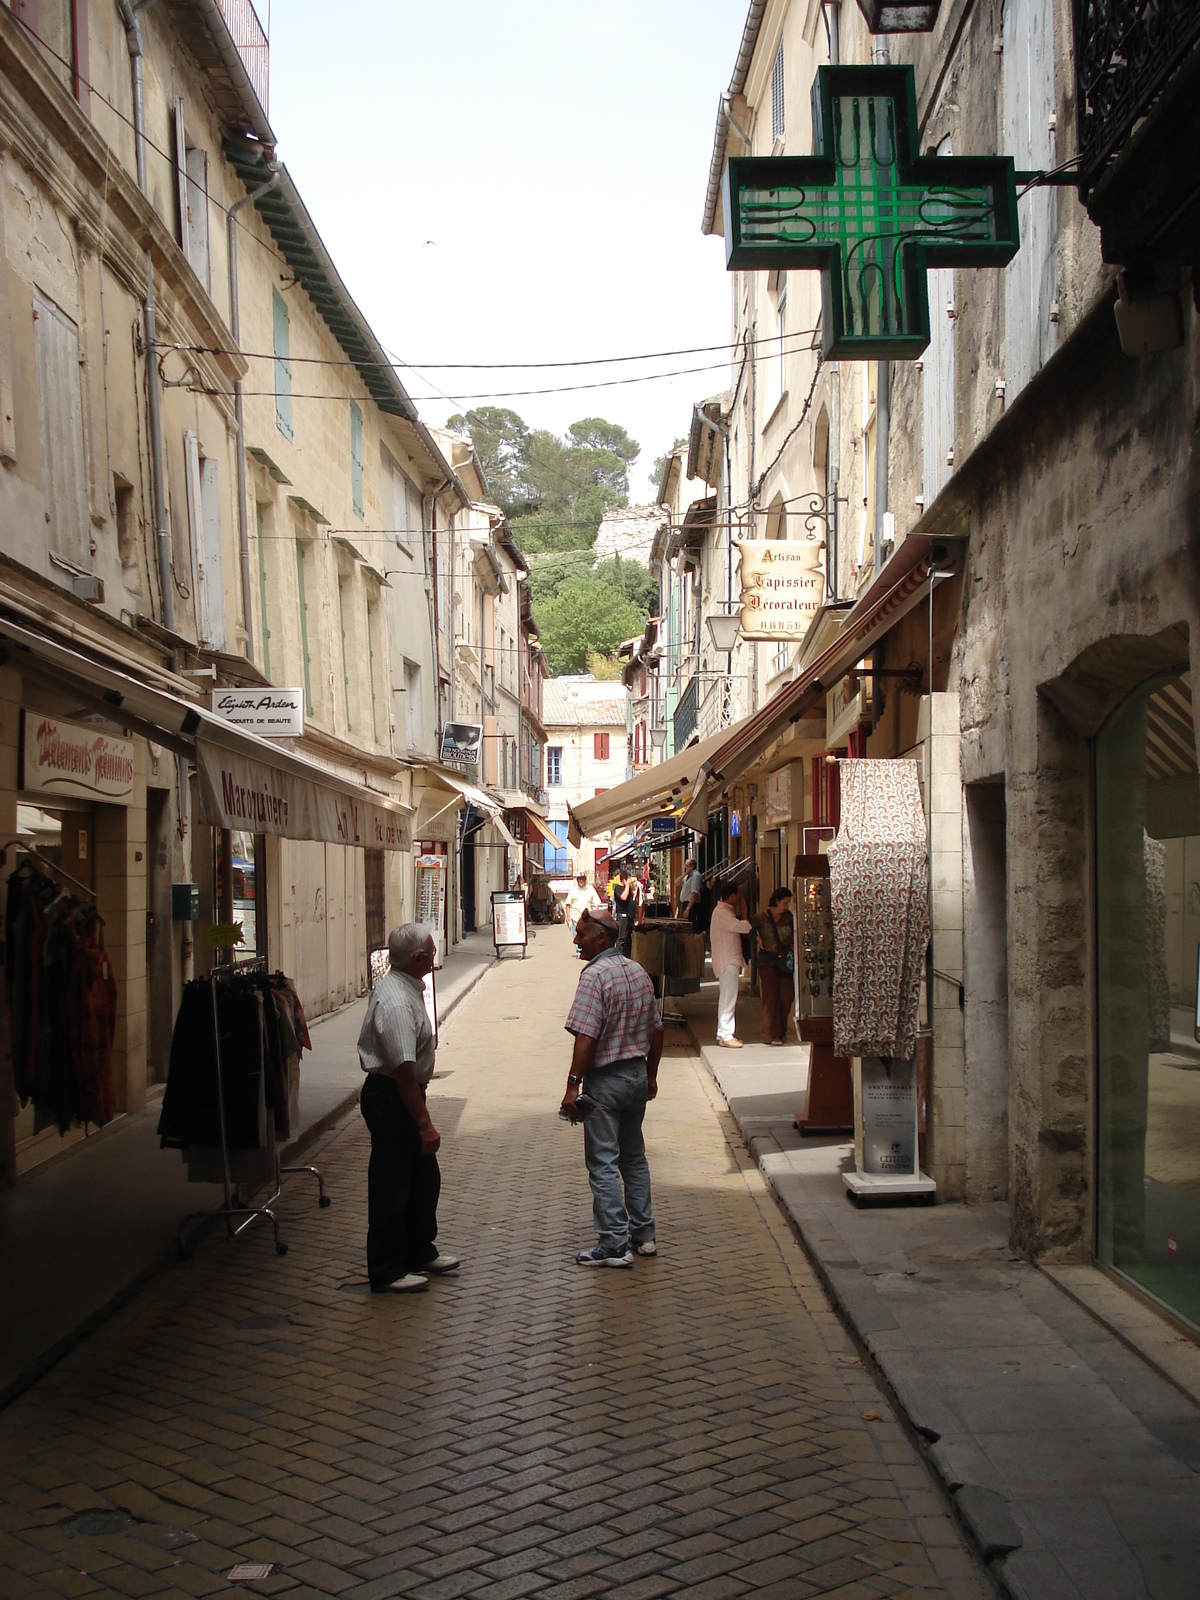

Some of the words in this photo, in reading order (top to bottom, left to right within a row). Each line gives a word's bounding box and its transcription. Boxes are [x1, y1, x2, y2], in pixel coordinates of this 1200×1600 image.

[761, 549, 801, 563] Artisan
[750, 571, 817, 591] Tapissier
[748, 594, 819, 612] Décorateur
[255, 696, 298, 710] Arden
